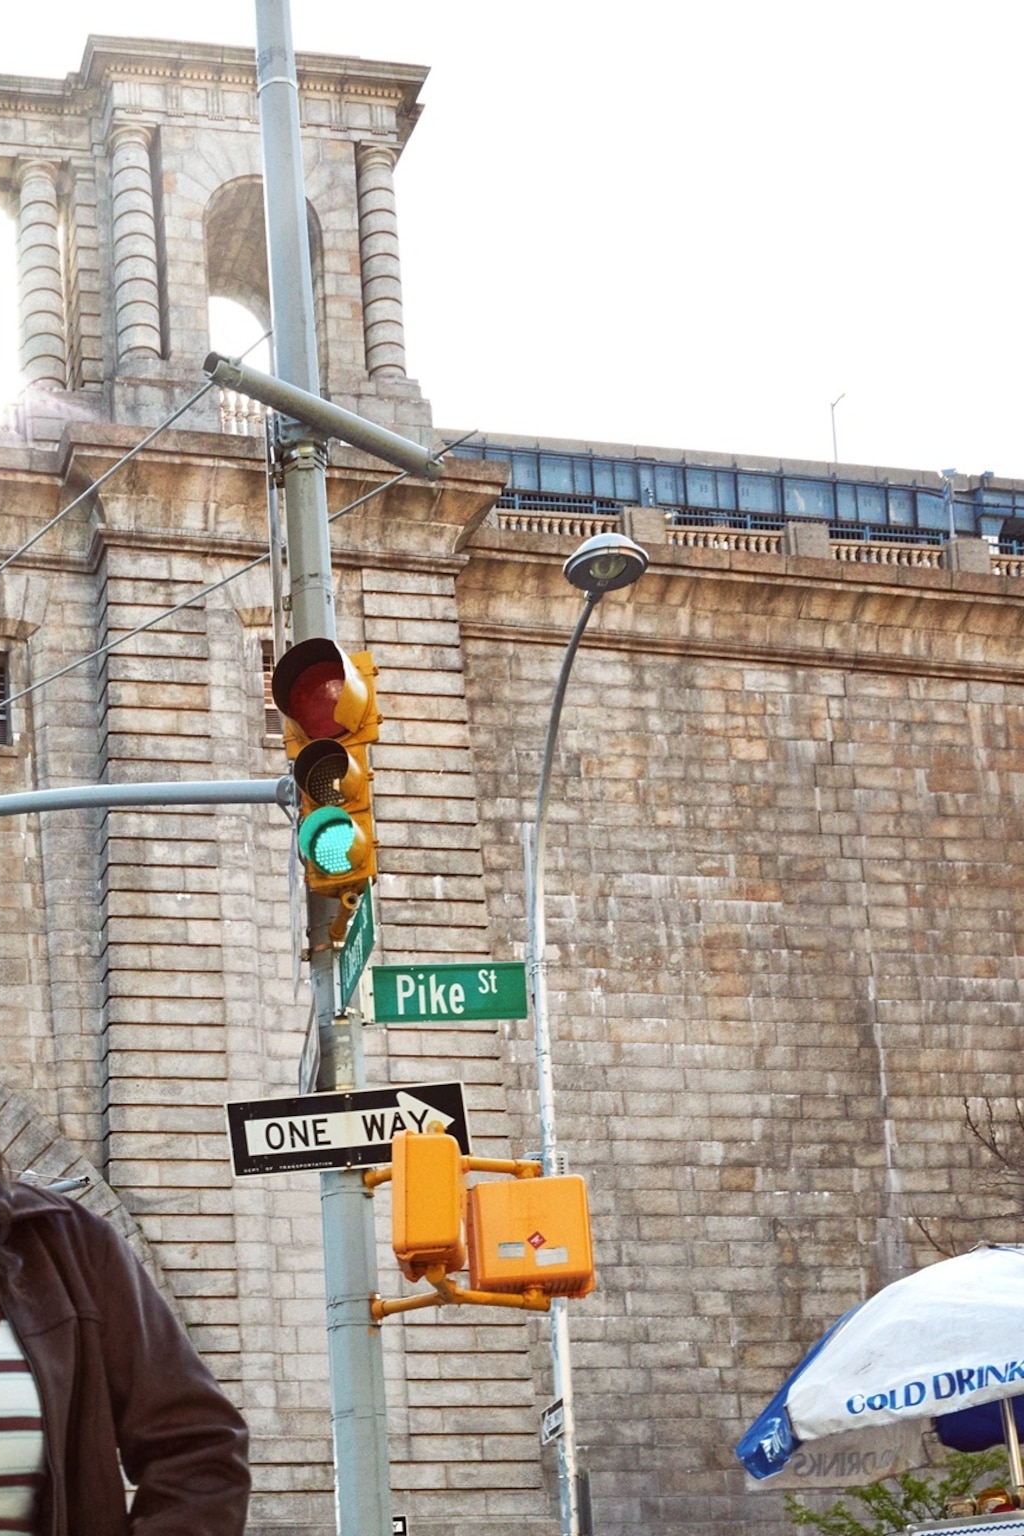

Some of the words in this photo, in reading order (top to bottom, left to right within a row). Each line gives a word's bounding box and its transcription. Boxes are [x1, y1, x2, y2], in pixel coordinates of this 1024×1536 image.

[396, 973, 466, 1015] Pike
[478, 969, 498, 994] St
[265, 1118, 332, 1150] ONE
[361, 1109, 429, 1142] WAY
[279, 1161, 334, 1170] TRANSPORTATION
[845, 1380, 926, 1415] COLD
